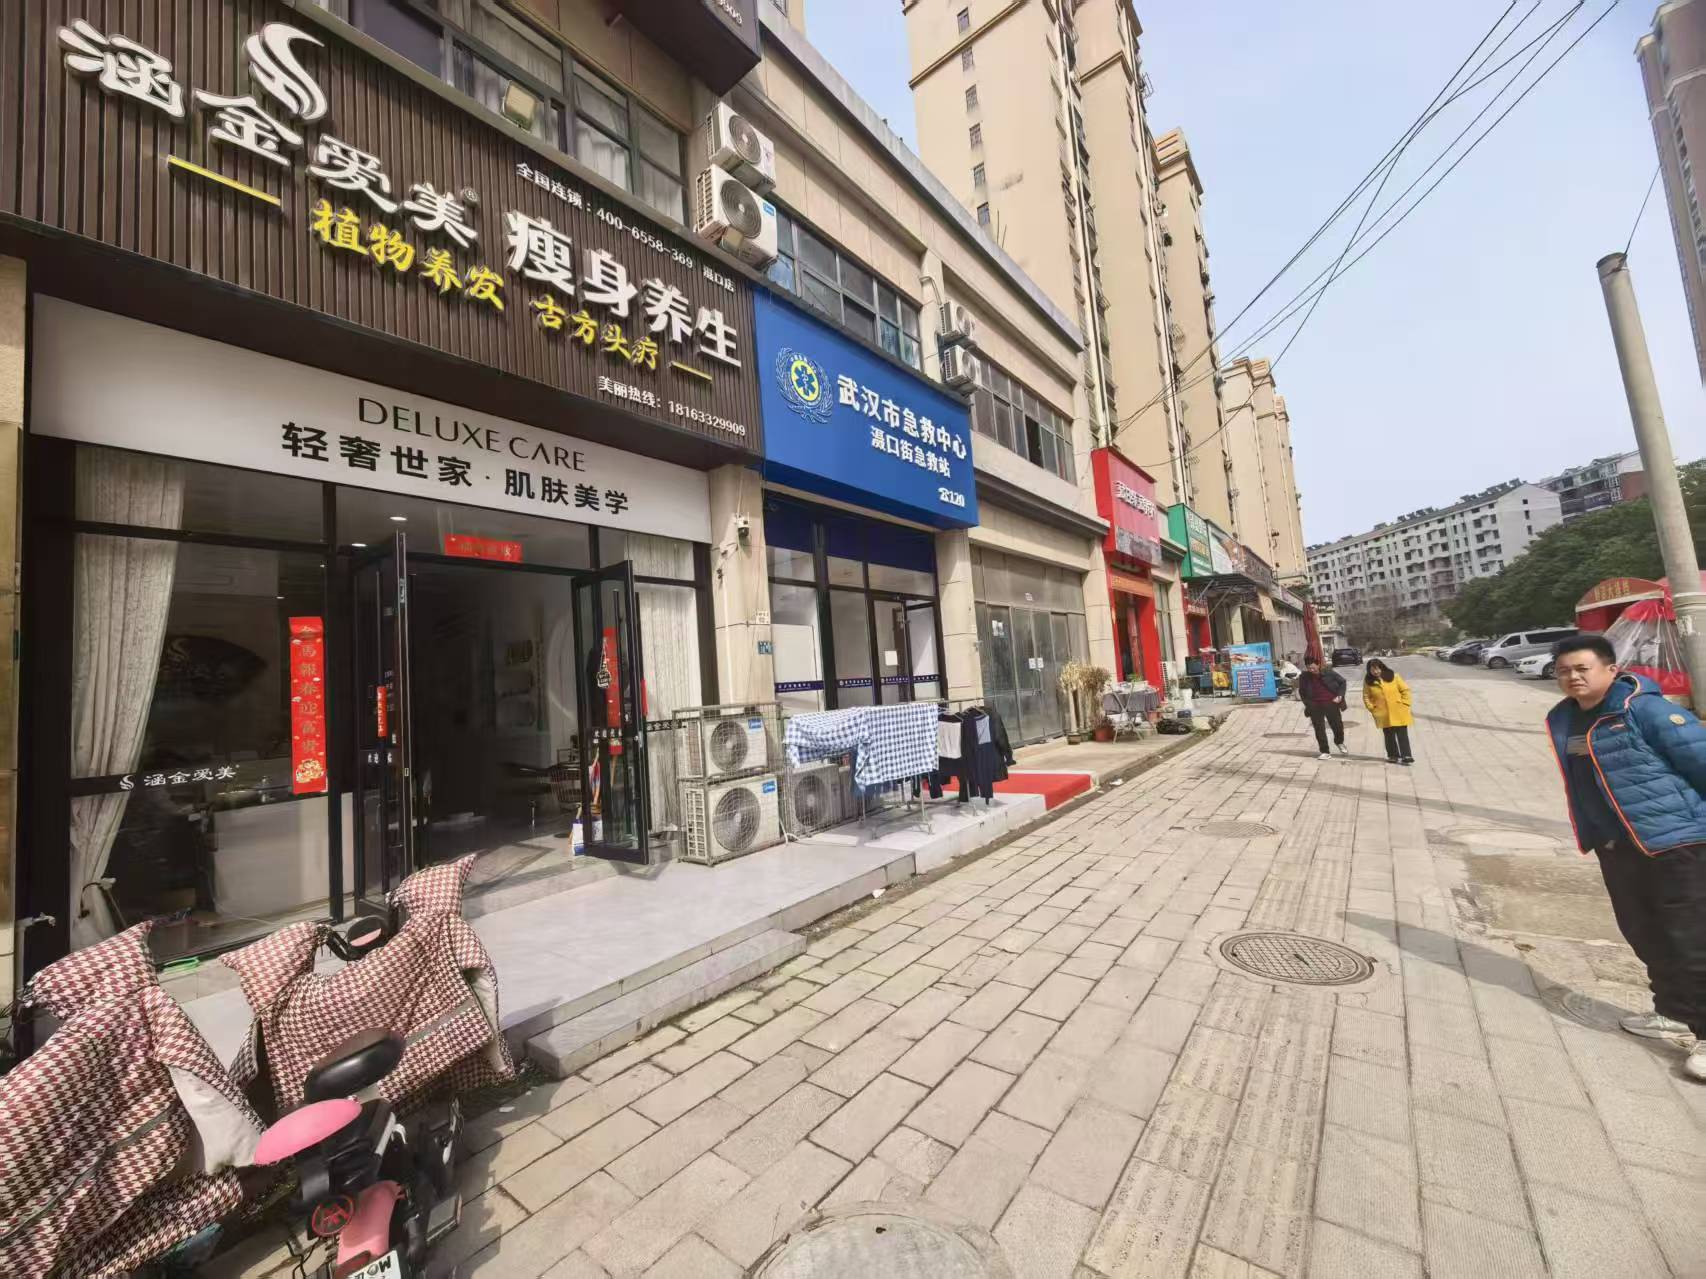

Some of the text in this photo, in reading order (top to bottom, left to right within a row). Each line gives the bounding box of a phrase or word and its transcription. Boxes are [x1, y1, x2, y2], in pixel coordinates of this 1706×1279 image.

[312, 200, 659, 370] 植物养发 古方头疗
[504, 209, 741, 368] 瘦身养生
[357, 397, 586, 472] DELUXE CARE
[837, 373, 967, 460] 武汉市急救中心
